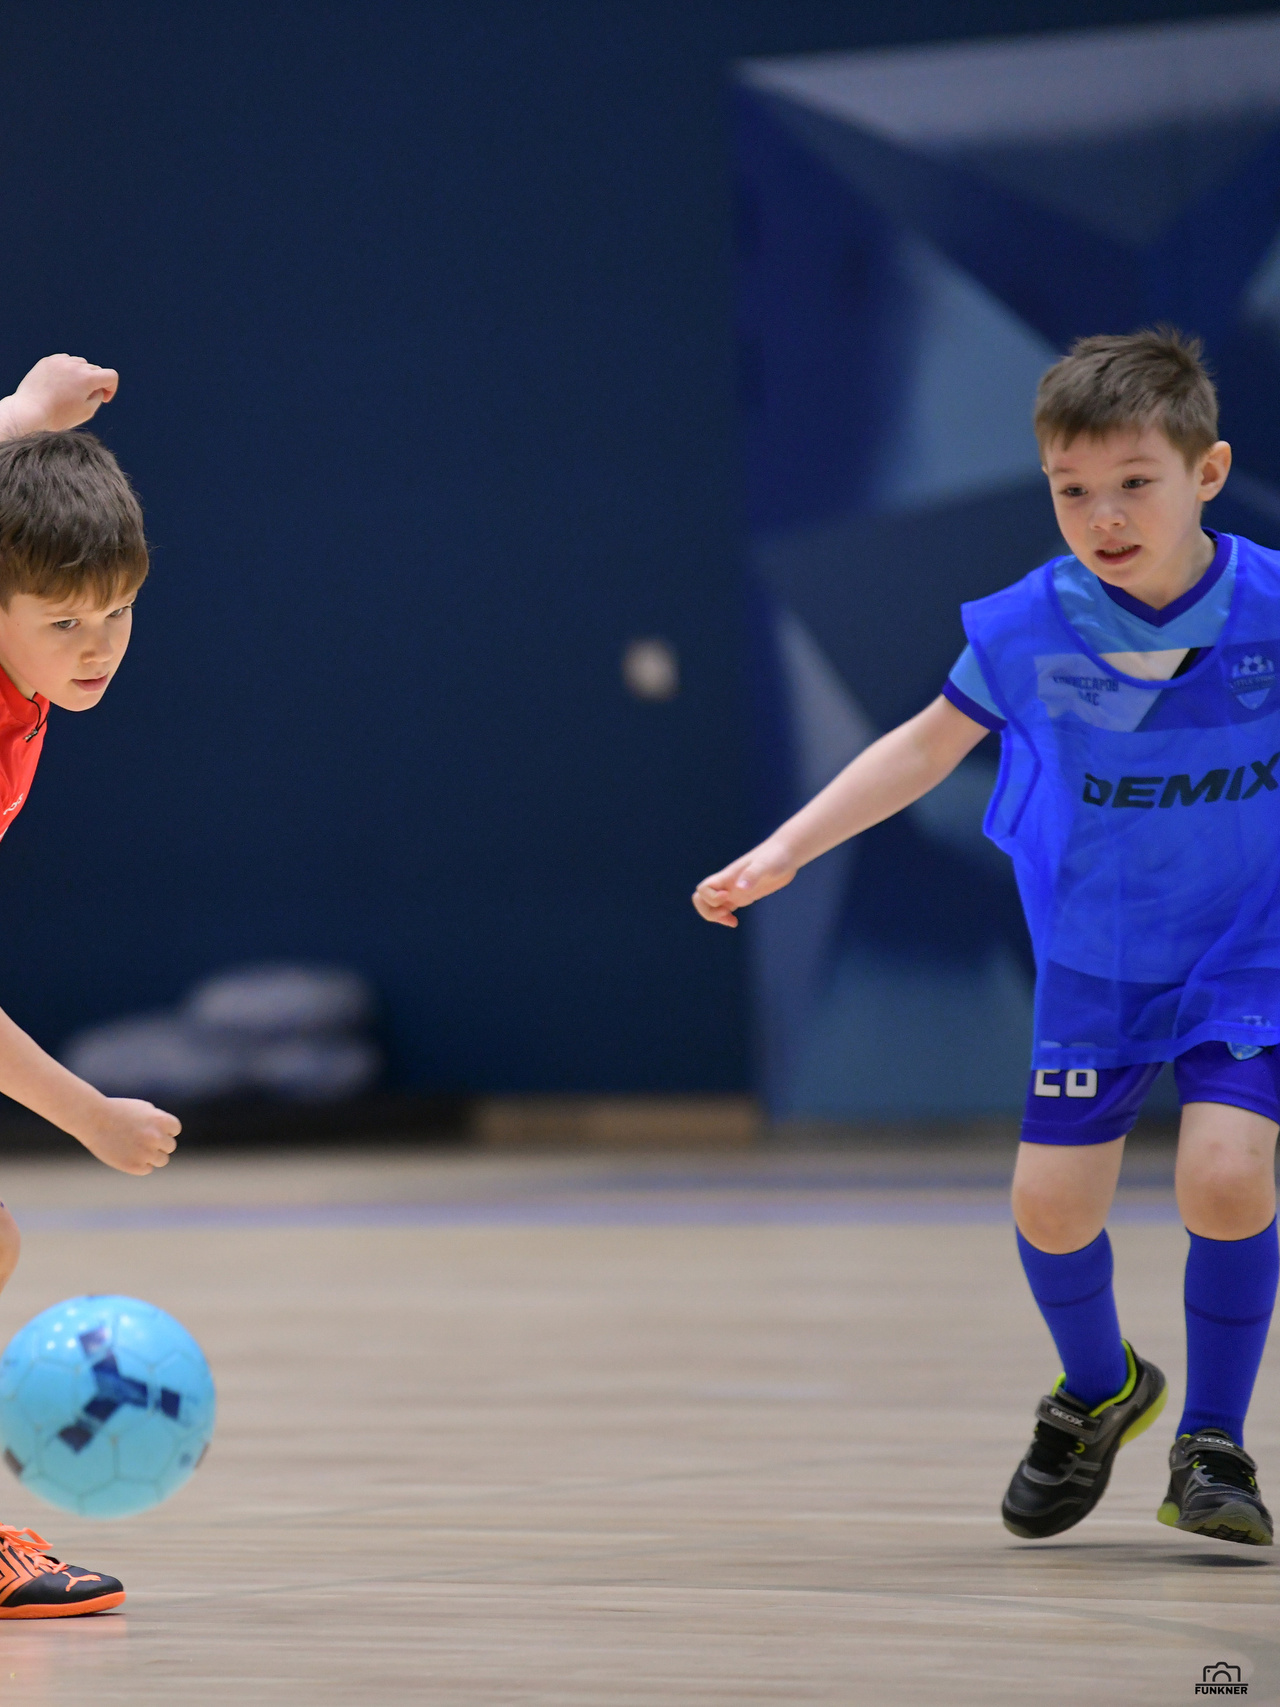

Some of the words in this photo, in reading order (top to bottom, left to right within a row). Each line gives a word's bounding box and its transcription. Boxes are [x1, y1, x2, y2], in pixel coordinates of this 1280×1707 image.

[1082, 752, 1280, 809] DEMIX
[1050, 1407, 1084, 1427] GEOX
[1197, 1437, 1235, 1448] GEOX
